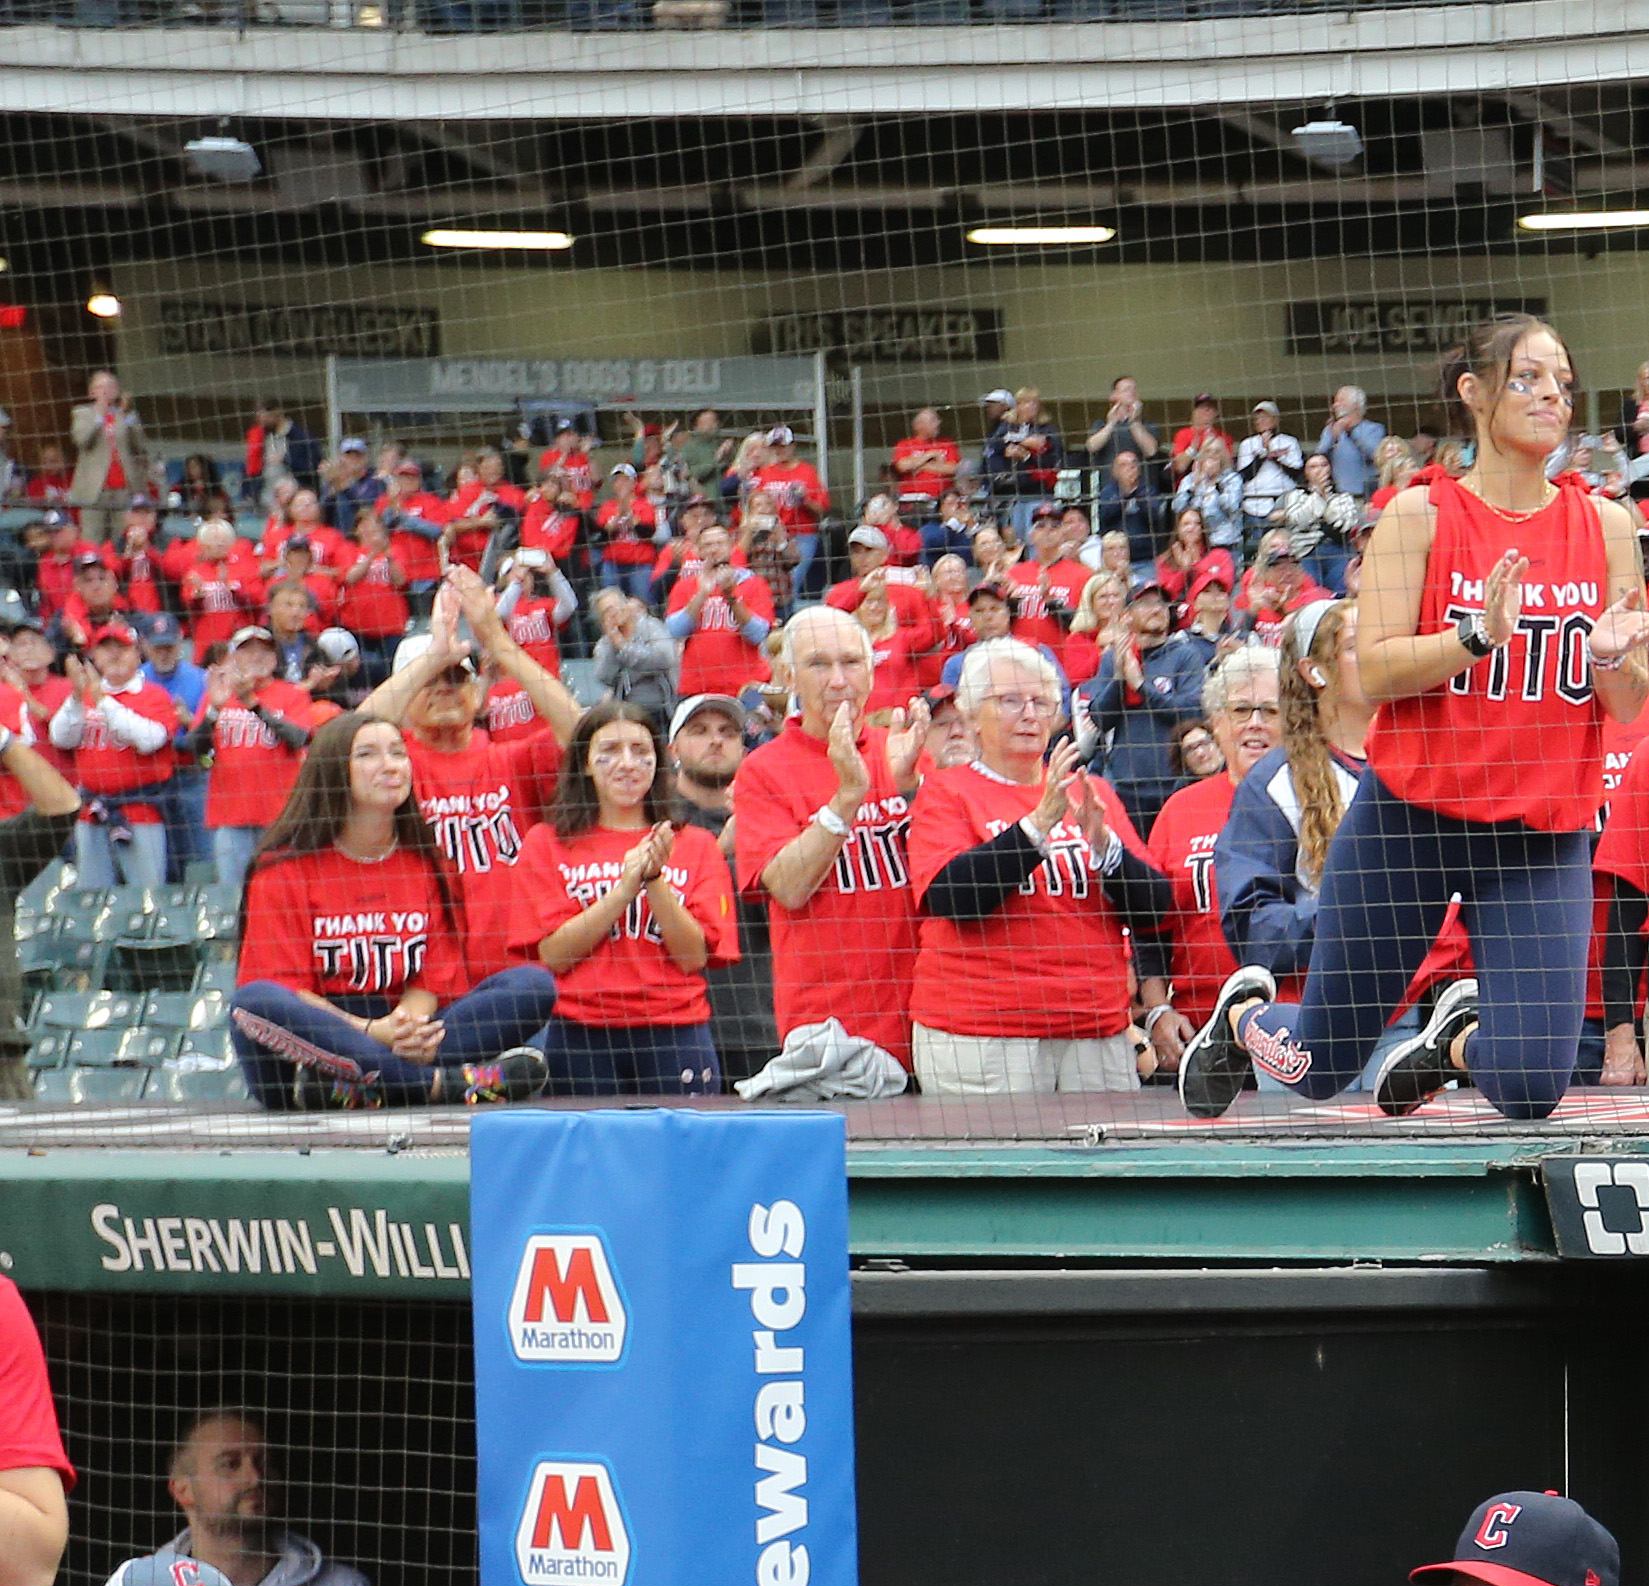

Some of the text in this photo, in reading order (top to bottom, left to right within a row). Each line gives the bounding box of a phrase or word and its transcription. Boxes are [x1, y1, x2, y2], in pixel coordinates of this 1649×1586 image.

[846, 312, 978, 355] SPEAKER
[1326, 304, 1380, 347] JOE
[662, 357, 721, 394] DELI
[1556, 581, 1598, 607] YOU
[314, 912, 387, 937] THANK
[92, 1203, 471, 1282] SHERWIN-WILLI
[521, 1328, 614, 1350] Marathon
[1474, 1502, 1523, 1551] C
[528, 1554, 618, 1578] Marathon
